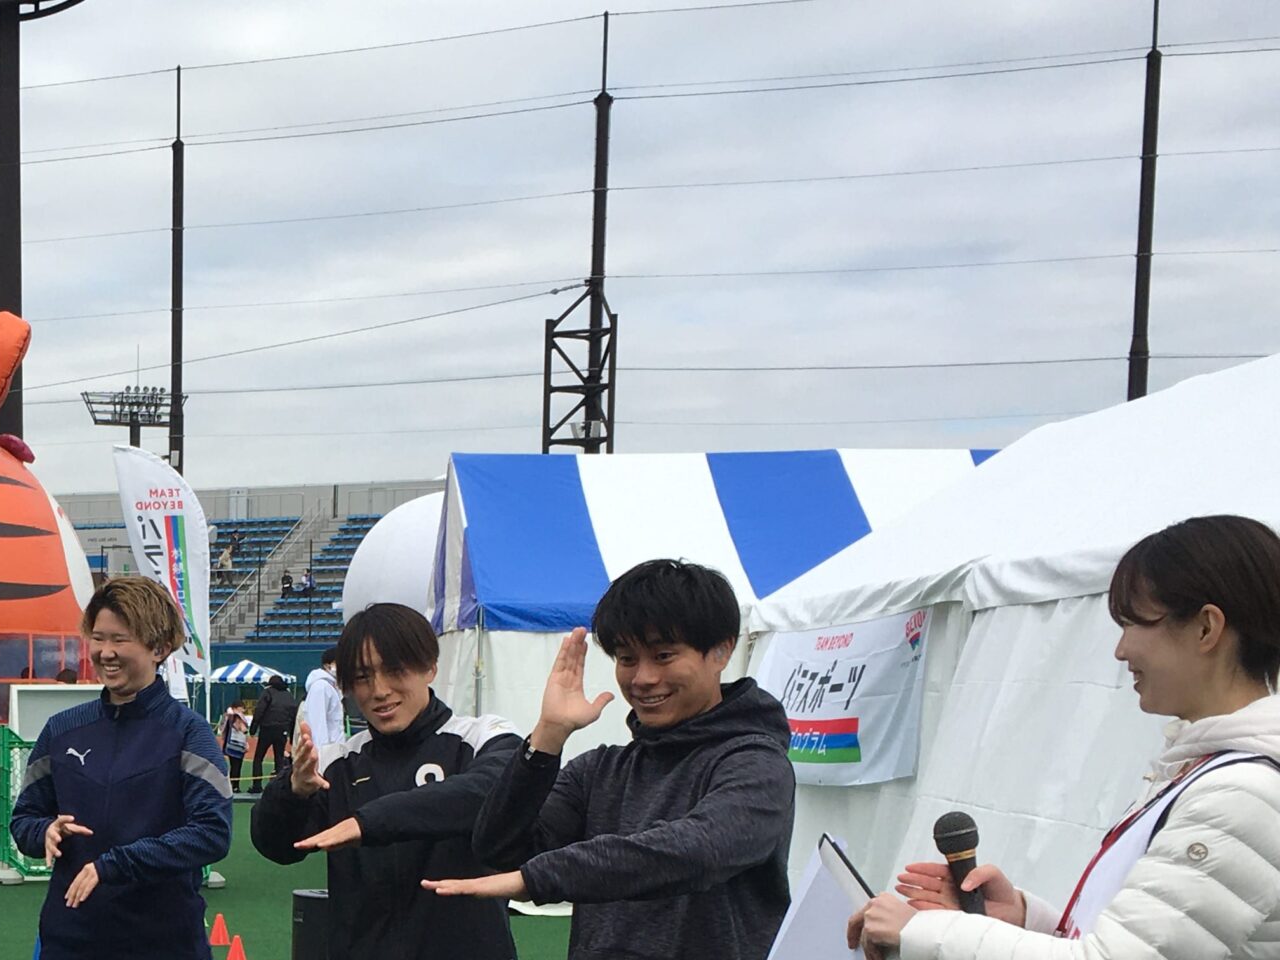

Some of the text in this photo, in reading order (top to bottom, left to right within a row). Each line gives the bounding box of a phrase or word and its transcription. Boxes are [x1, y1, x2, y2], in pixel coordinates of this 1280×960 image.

[780, 659, 867, 713] パラスポーツ
